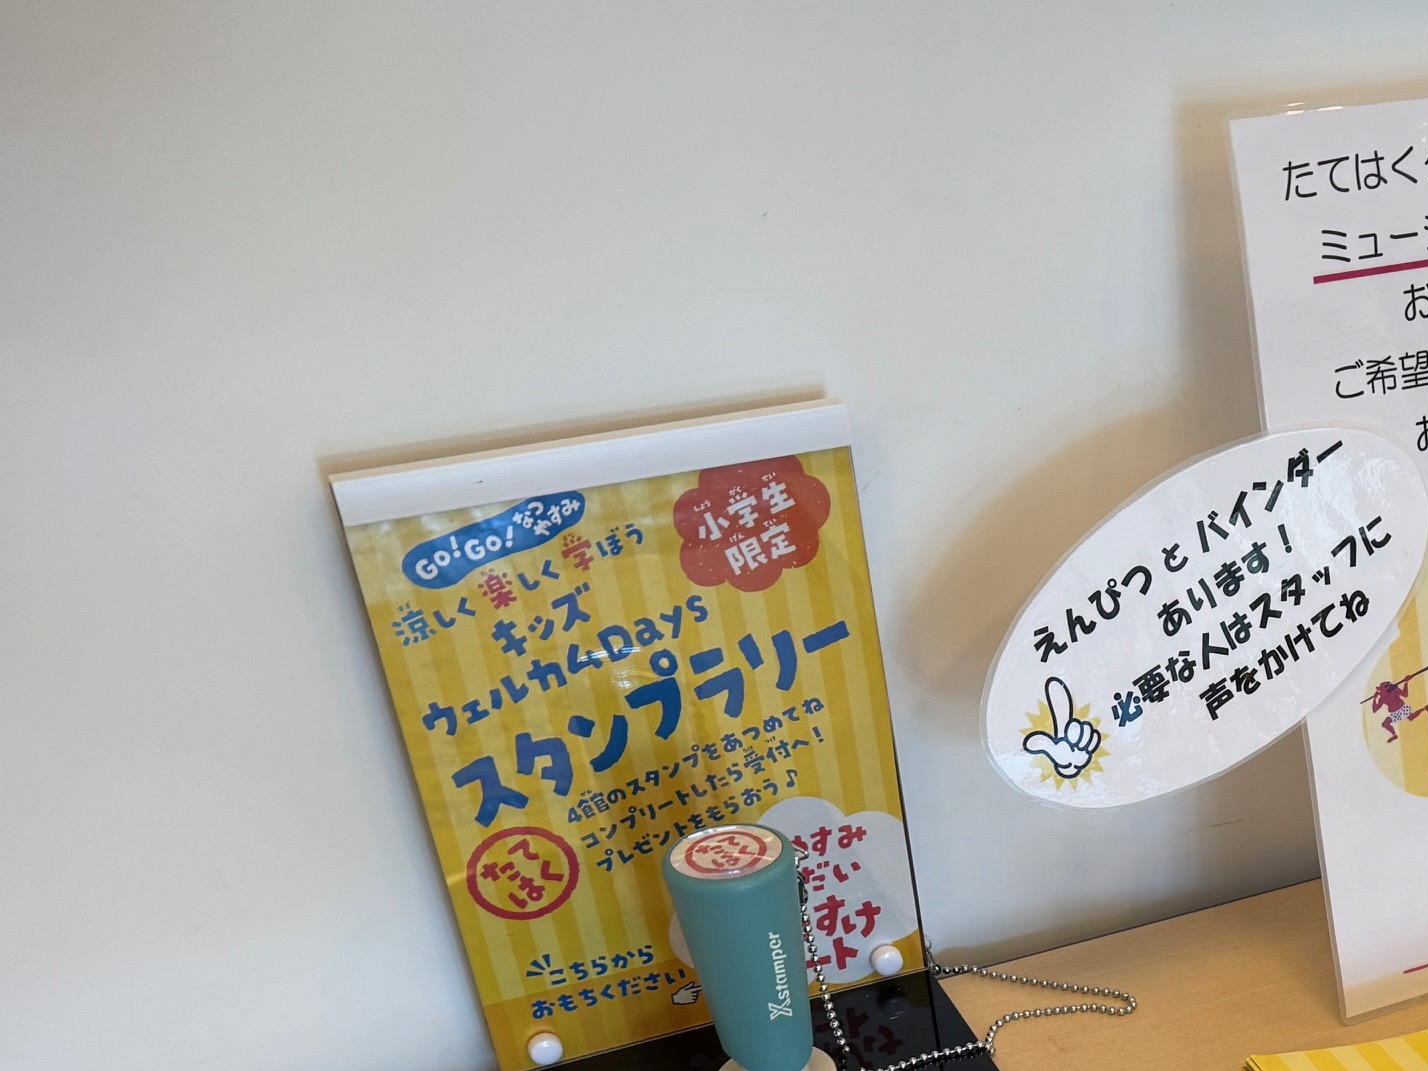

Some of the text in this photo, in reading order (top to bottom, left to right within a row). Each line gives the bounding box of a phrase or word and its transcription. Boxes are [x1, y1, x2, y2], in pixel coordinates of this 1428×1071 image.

[513, 501, 544, 529] なつ
[534, 498, 581, 536] やすみ
[699, 481, 796, 540] 小学生
[725, 523, 796, 575] 限定
[492, 582, 591, 657] キッズ
[1108, 515, 1394, 731] 必要な人はスタッフに
[1199, 589, 1371, 722] 声をかけてね
[422, 595, 709, 738] ウェルカムDays
[451, 621, 850, 828] スタンプラリー
[567, 698, 825, 824] 4館のスタンプをあつめてね
[581, 727, 824, 848] コンプリートしたら受付へ!
[530, 968, 686, 1020] おもちください
[549, 943, 654, 987] こちらから
